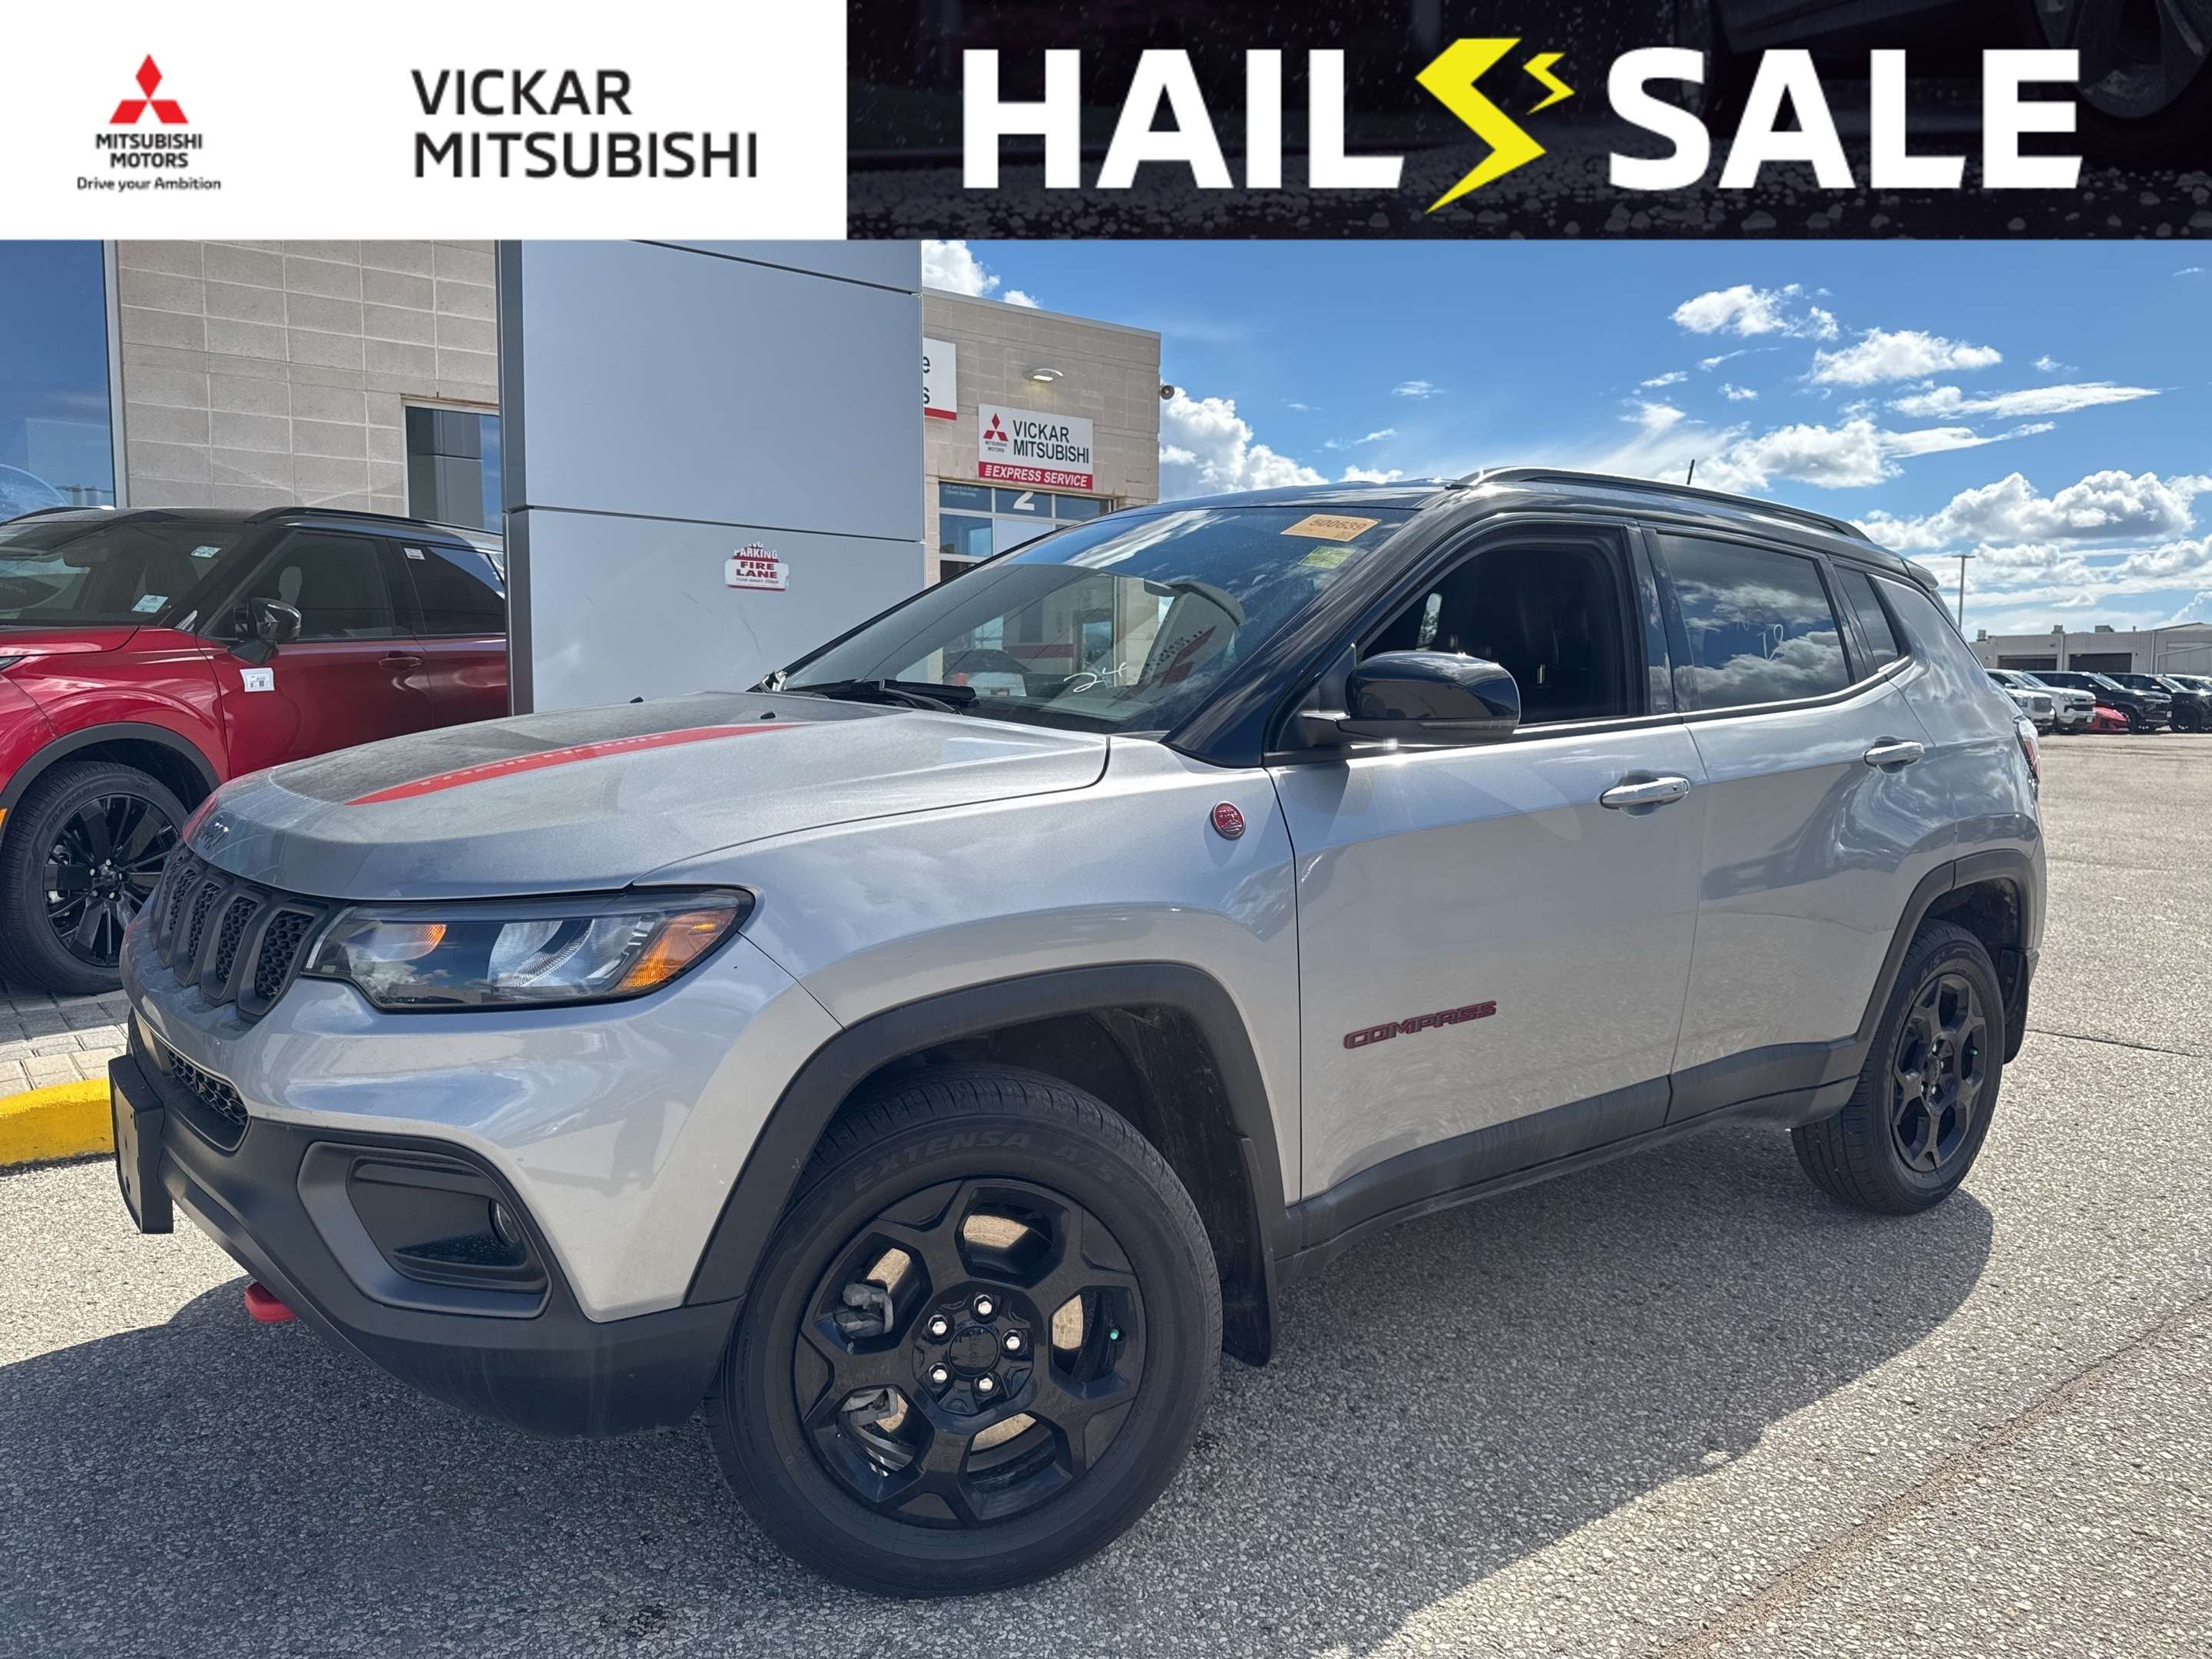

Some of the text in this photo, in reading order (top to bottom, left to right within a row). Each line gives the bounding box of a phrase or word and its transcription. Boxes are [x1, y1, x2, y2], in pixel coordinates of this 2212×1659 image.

[1013, 419, 1069, 443] VICKAR
[1014, 439, 1089, 464] MITSUBISHI
[992, 465, 1088, 487] EXPRESS SERVICE
[1013, 492, 1035, 511] 2
[736, 568, 778, 579] LANE
[740, 561, 775, 571] FIRE
[1343, 1000, 1497, 1049] COMPASS
[853, 1131, 1033, 1192] EXTENSA
